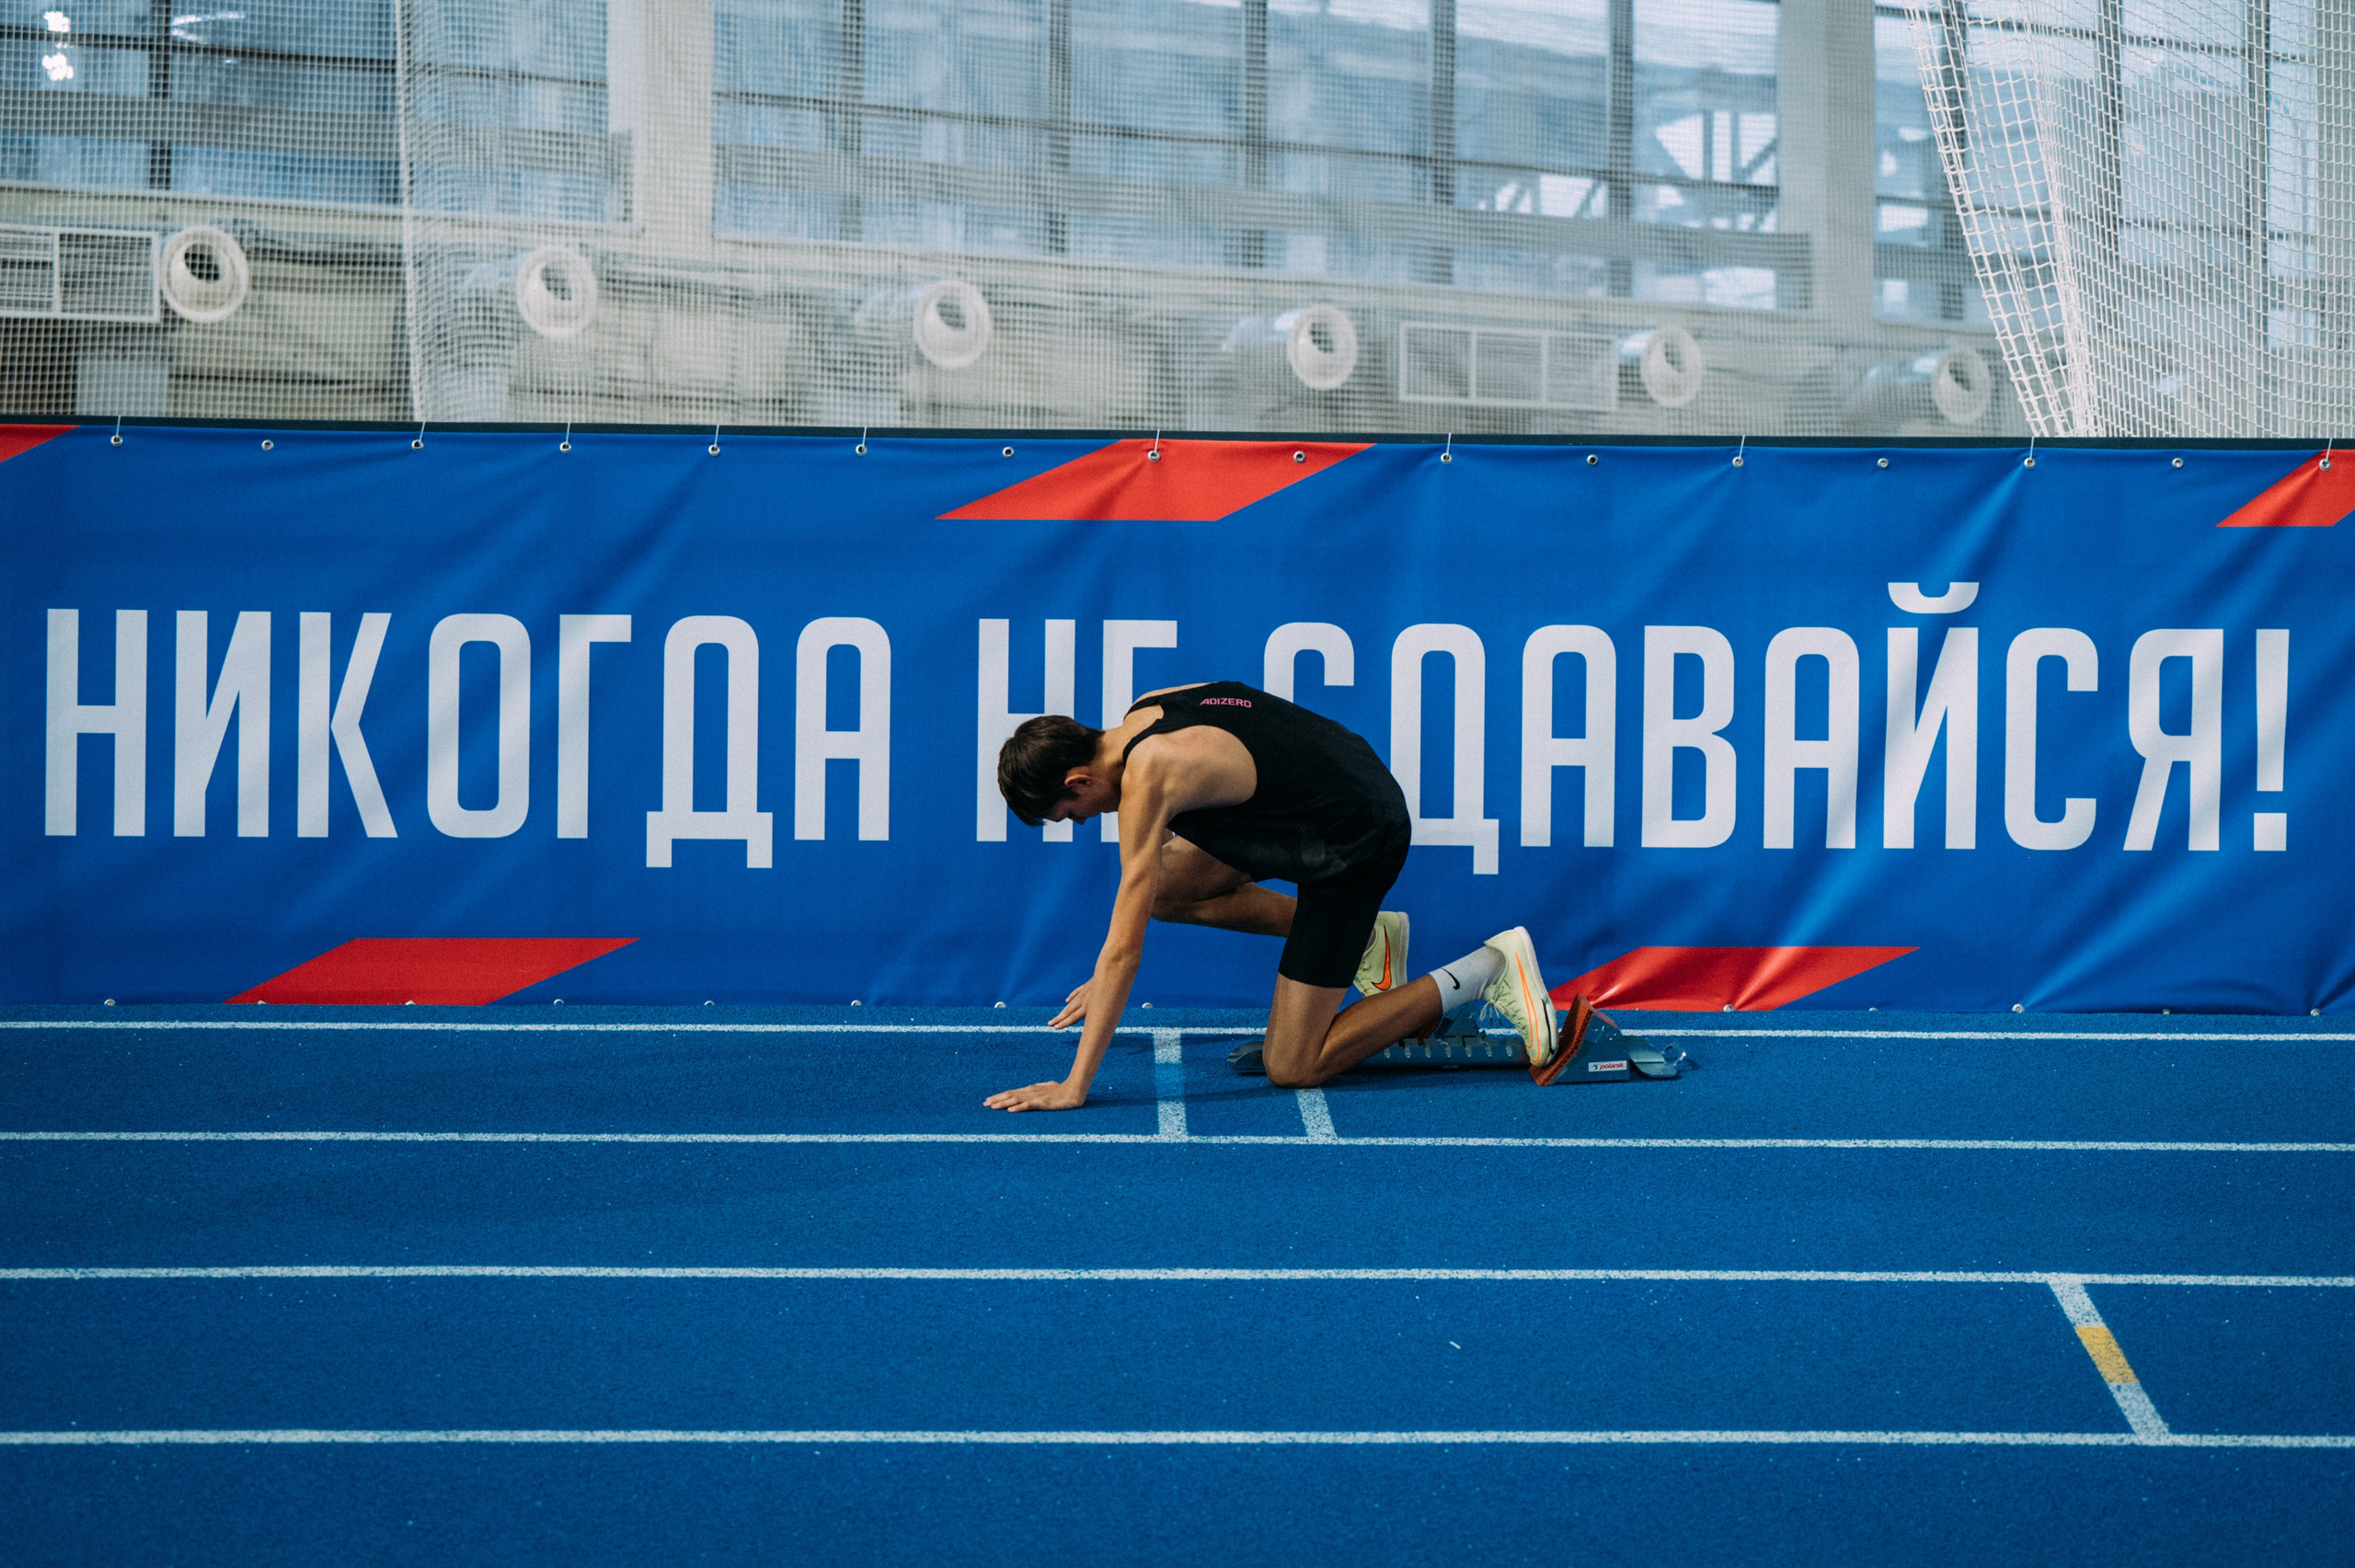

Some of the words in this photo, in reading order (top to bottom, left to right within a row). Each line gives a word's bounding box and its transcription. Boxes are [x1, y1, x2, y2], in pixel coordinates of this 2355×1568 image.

[1200, 698, 1252, 708] ADIZERO
[45, 608, 891, 869] НИКОГДА
[1599, 1062, 1625, 1070] polanik
